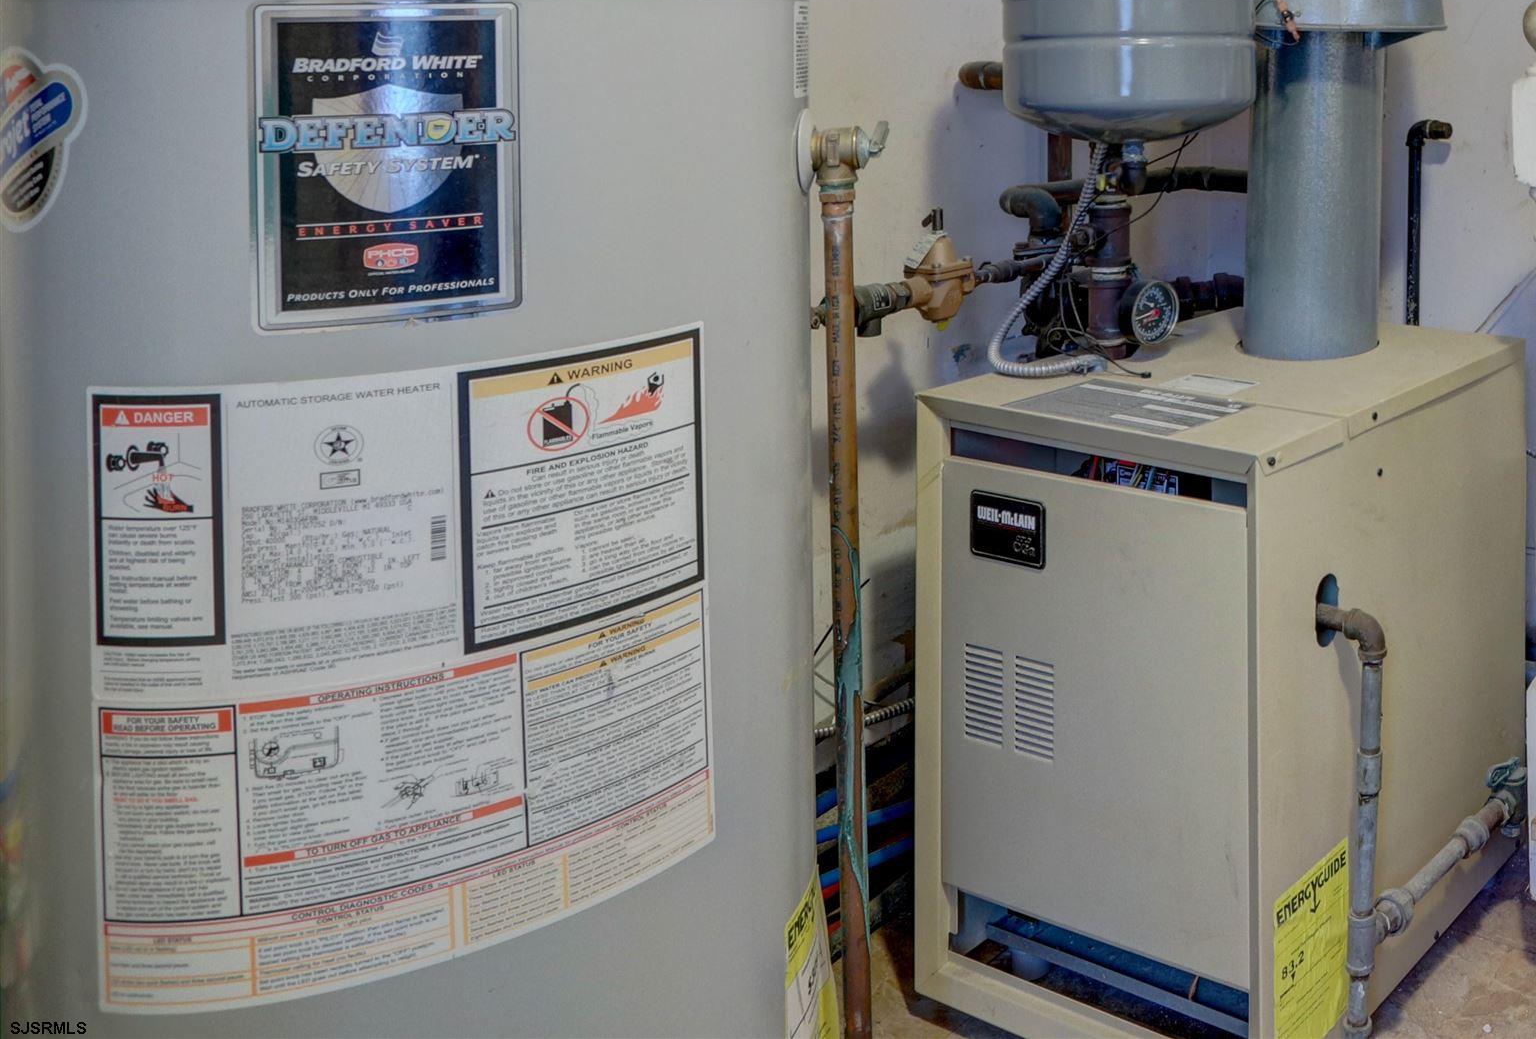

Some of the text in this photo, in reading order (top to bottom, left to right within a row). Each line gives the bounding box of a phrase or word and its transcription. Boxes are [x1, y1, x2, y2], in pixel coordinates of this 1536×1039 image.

[292, 55, 482, 74] BRADFORD WHITE
[307, 71, 464, 83] CORPORATION
[259, 108, 517, 153] DEFENDER
[297, 154, 479, 177] SAFETY SYSTEM
[299, 215, 483, 237] ENERGY SAVER
[368, 248, 416, 259] PHCC
[287, 277, 495, 302] PRODUCTS ONLY FOR PROFESSIONALS
[567, 359, 633, 380] WARNING
[236, 383, 440, 409] AUTOMATIC STORAGE WATER HEATER
[134, 412, 194, 423] DANGER
[592, 421, 654, 441] Flammable Vapors
[526, 441, 648, 476] FIRE AND EXPLOSION HAZARD
[153, 473, 173, 482] HOT
[609, 619, 645, 635] WARNING
[318, 673, 445, 703] OPERATING INSTRUCTIONS
[321, 843, 347, 853] TURN
[349, 837, 368, 848] OFF
[370, 833, 391, 845] GAS
[394, 830, 407, 838] TO
[408, 815, 461, 836] APPLIANCE
[1276, 850, 1347, 929] ENERGYGUIDE
[292, 883, 434, 921] CONTROL DIAGNOSTIC CODES
[1281, 950, 1305, 980] 83.2
